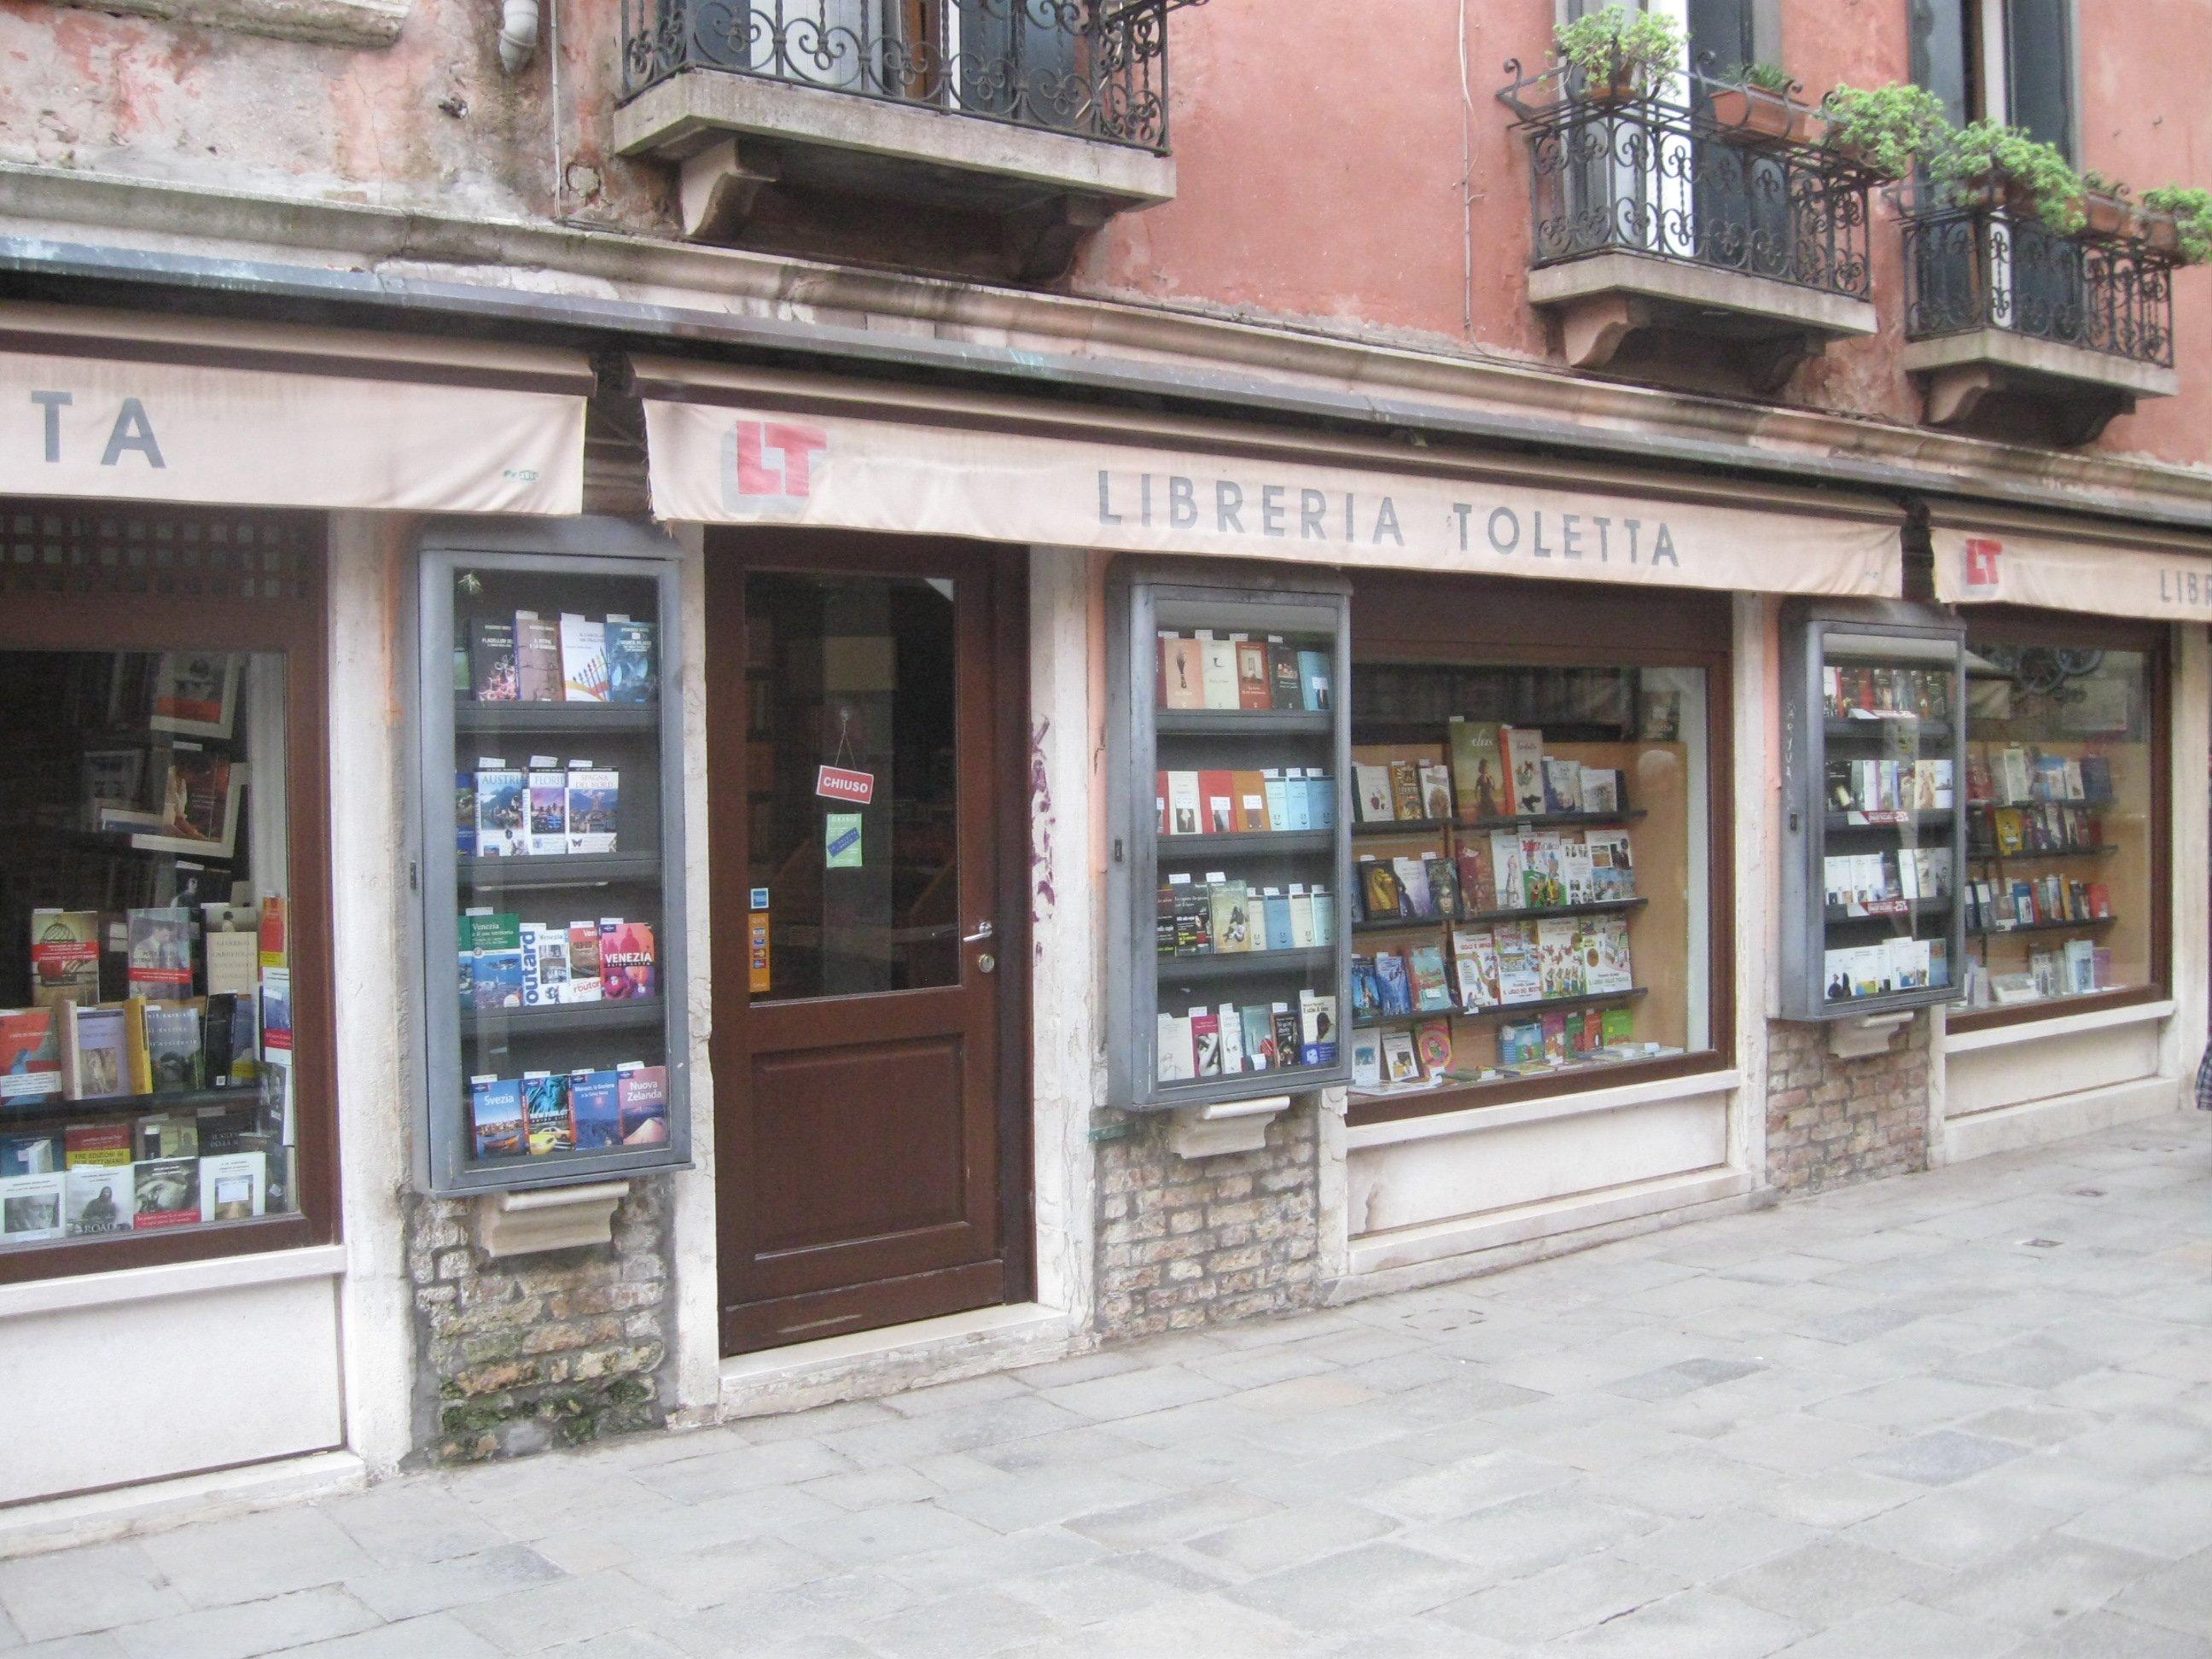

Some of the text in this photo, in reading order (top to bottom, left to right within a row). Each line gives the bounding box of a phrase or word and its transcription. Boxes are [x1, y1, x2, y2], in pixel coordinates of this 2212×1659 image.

[736, 420, 827, 498] LT
[1097, 469, 1680, 568] LIBRERIA TOLETTA
[1965, 538, 2003, 585] LT
[823, 776, 869, 795] CHIUSO
[473, 923, 500, 931] Venezia
[604, 952, 653, 963] VENEZIA
[519, 931, 539, 1005] outard
[630, 1080, 659, 1091] Nuova
[484, 1093, 515, 1106] Svezia
[626, 1089, 663, 1102] Zelanda
